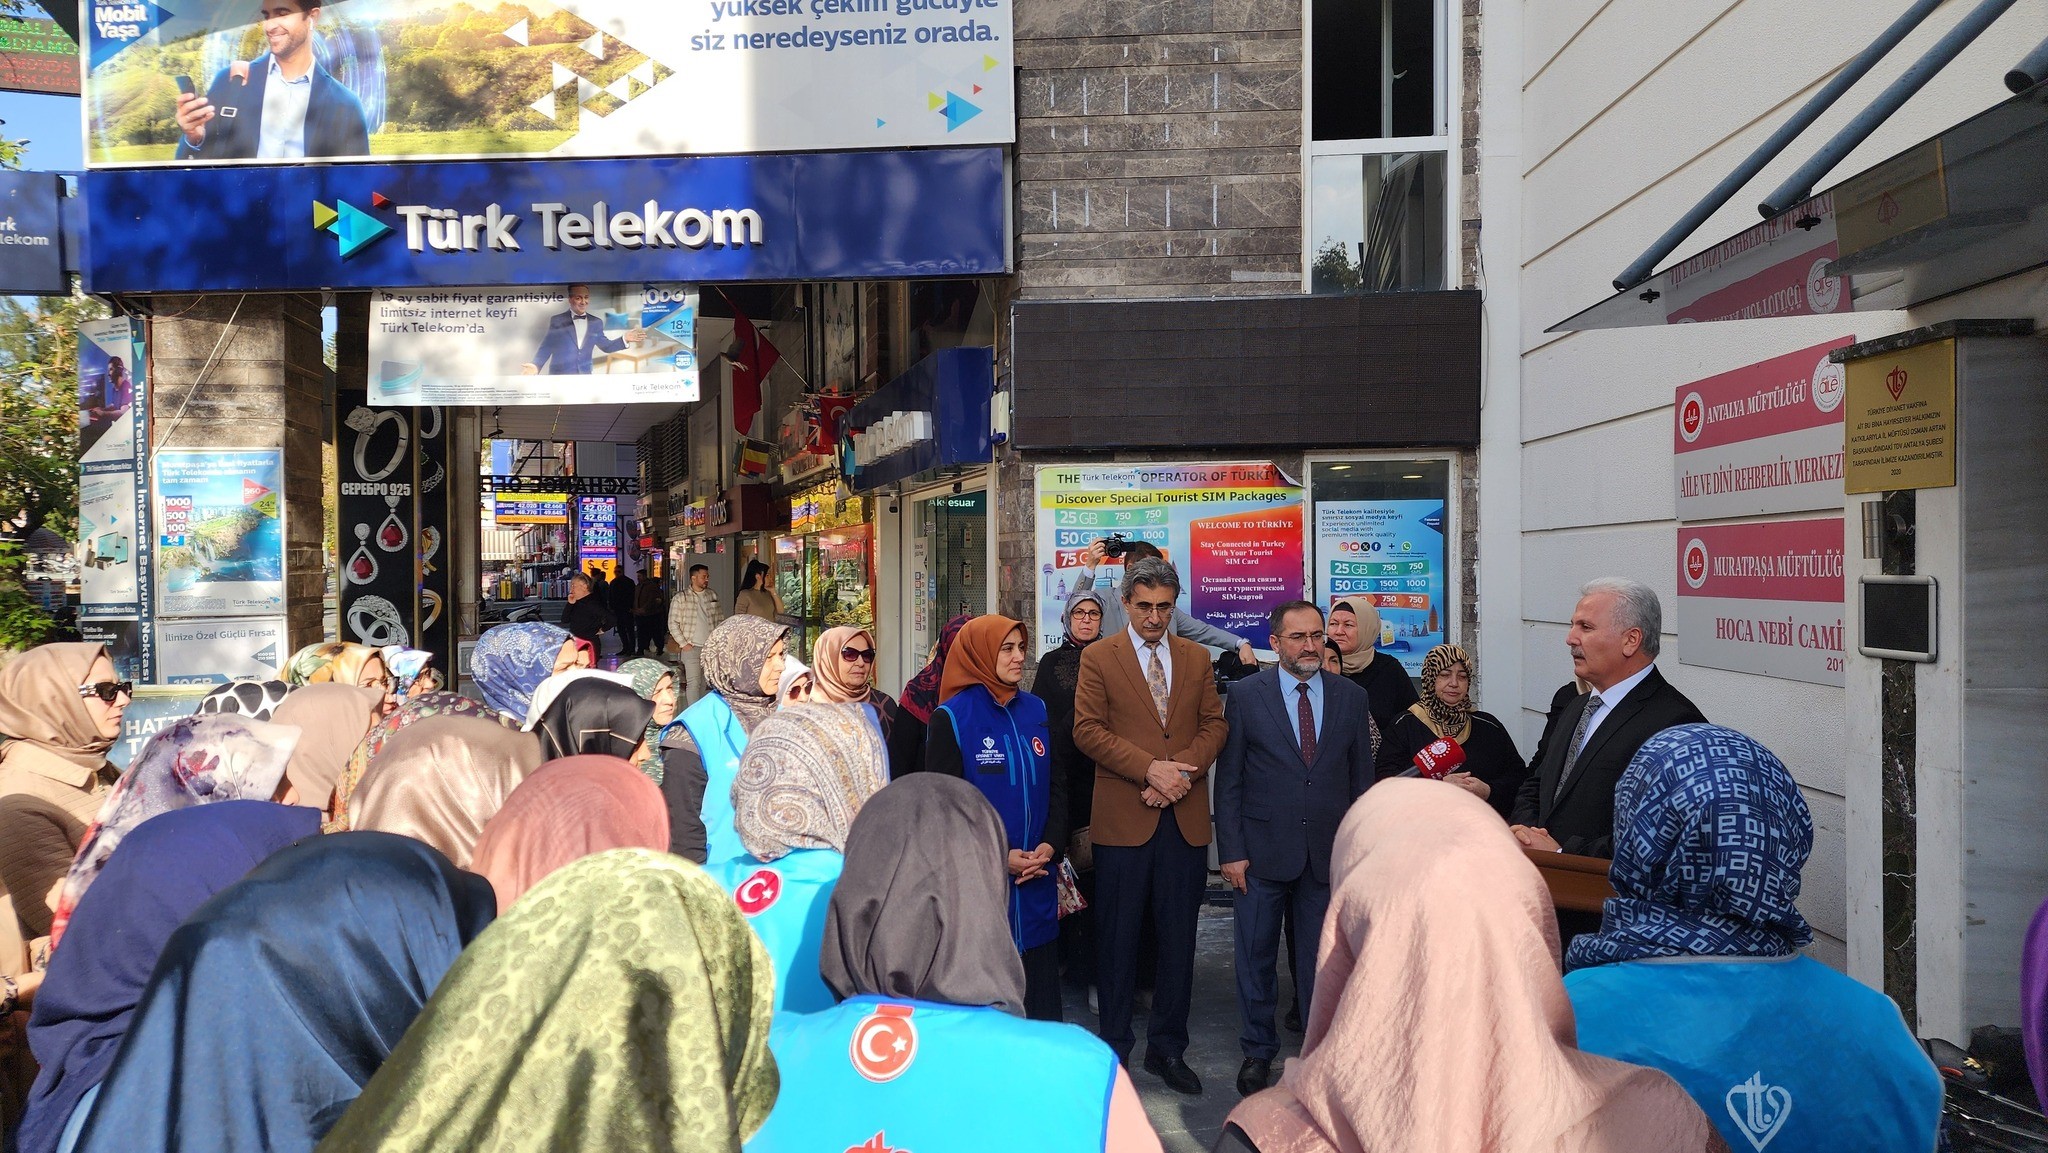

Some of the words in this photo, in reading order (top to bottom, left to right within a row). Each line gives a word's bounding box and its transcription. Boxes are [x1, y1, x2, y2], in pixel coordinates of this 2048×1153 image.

[95, 4, 148, 22] Mobil
[95, 22, 141, 42] Yaşa
[691, 28, 725, 50] siz
[733, 22, 907, 51] neredeyseniz
[914, 19, 999, 43] orada.
[396, 200, 522, 252] Türk
[531, 199, 763, 251] Telekom
[398, 294, 412, 305] ay
[416, 293, 449, 303] sabit
[452, 293, 483, 304] fiyat
[486, 291, 564, 305] garantisiyle
[380, 307, 427, 318] limitsiz
[431, 307, 482, 318] internet
[486, 307, 518, 319] keyfi
[380, 322, 409, 333] Türk
[411, 322, 485, 334] Telekom'da
[671, 320, 683, 330] 18
[650, 383, 681, 391] Telekom
[136, 382, 144, 417] Türk
[1707, 399, 1745, 424] ANTALYA
[1747, 379, 1807, 415] MÜFTÜLÜĞÜ
[1887, 403, 1905, 413] DİYANET
[136, 420, 144, 485] Telekom
[1057, 474, 1080, 484] THE
[1102, 473, 1135, 481] Telekom
[1141, 472, 1207, 483] OPERATOR
[1211, 471, 1227, 481] OF
[1681, 470, 1698, 498] AİLE
[1700, 473, 1711, 495] VE
[1713, 463, 1732, 494] DİNİ
[1735, 455, 1791, 491] REHBERLİK
[341, 482, 388, 496] СЕРЕБРО
[389, 482, 411, 496] 925
[165, 498, 191, 506] 1000
[1056, 494, 1106, 504] Discover
[1110, 493, 1152, 505] Special
[1156, 492, 1198, 503] Tourist
[1202, 492, 1225, 502] SIM
[1230, 491, 1287, 504] Packages
[583, 504, 613, 512] 42.020
[1363, 508, 1395, 516] kalitesiyle
[137, 489, 147, 551] İnternet
[166, 512, 186, 520] 500
[1060, 510, 1076, 524] 25
[1079, 512, 1098, 525] GB
[1115, 512, 1131, 520] 750
[1145, 509, 1161, 519] 750
[167, 524, 186, 532] 100
[1198, 521, 1240, 529] WELCOME
[1257, 520, 1293, 528] TÜRKİYE
[583, 529, 613, 537] 48.770
[1060, 531, 1078, 545] 50
[1142, 530, 1165, 539] 1000
[1375, 531, 1397, 539] quality
[1217, 540, 1251, 548] Connected
[1261, 540, 1285, 548] Turkey
[1060, 553, 1077, 567] 75
[1713, 555, 1775, 583] MURATPAŞA
[1777, 549, 1845, 578] MÜFTÜLÜĞ
[1334, 562, 1349, 574] 25
[1351, 563, 1368, 574] GB
[1408, 562, 1423, 570] 750
[139, 555, 148, 618] Başvuru
[1233, 585, 1285, 593] туристической
[1335, 580, 1351, 591] 50
[1352, 580, 1368, 591] GB
[1408, 596, 1424, 604] 750
[165, 632, 193, 642] İlinize
[196, 631, 217, 640] Özel
[219, 630, 246, 640] Güçlü
[248, 629, 276, 638] Fırsat
[1716, 617, 1755, 642] HOCA
[1758, 616, 1793, 646] NEBİ
[1798, 618, 1845, 652] CAMİ
[142, 622, 151, 681] Noktası
